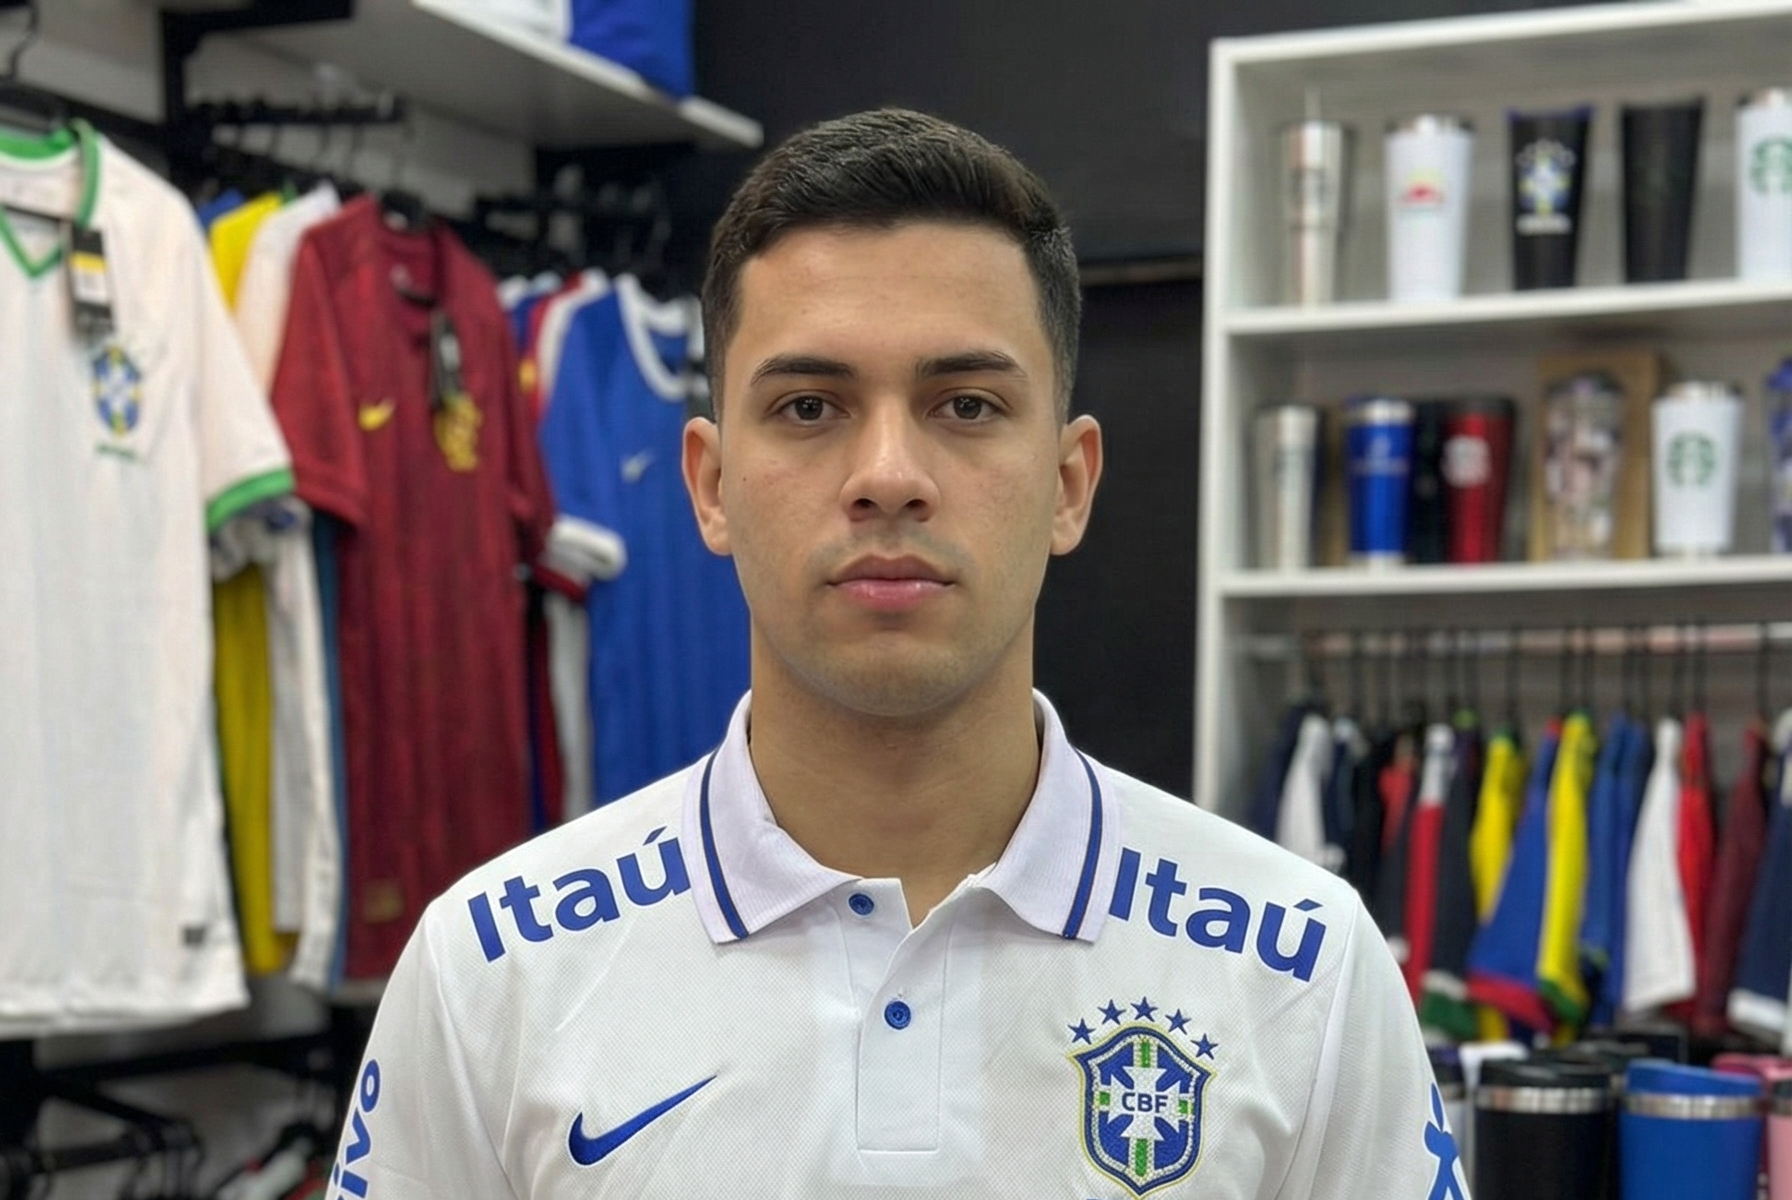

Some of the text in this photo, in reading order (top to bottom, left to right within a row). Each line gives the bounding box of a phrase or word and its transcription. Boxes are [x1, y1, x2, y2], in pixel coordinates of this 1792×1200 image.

[468, 827, 692, 962] Itaú
[1109, 847, 1327, 982] Itaú
[1121, 1092, 1168, 1113] CBF
